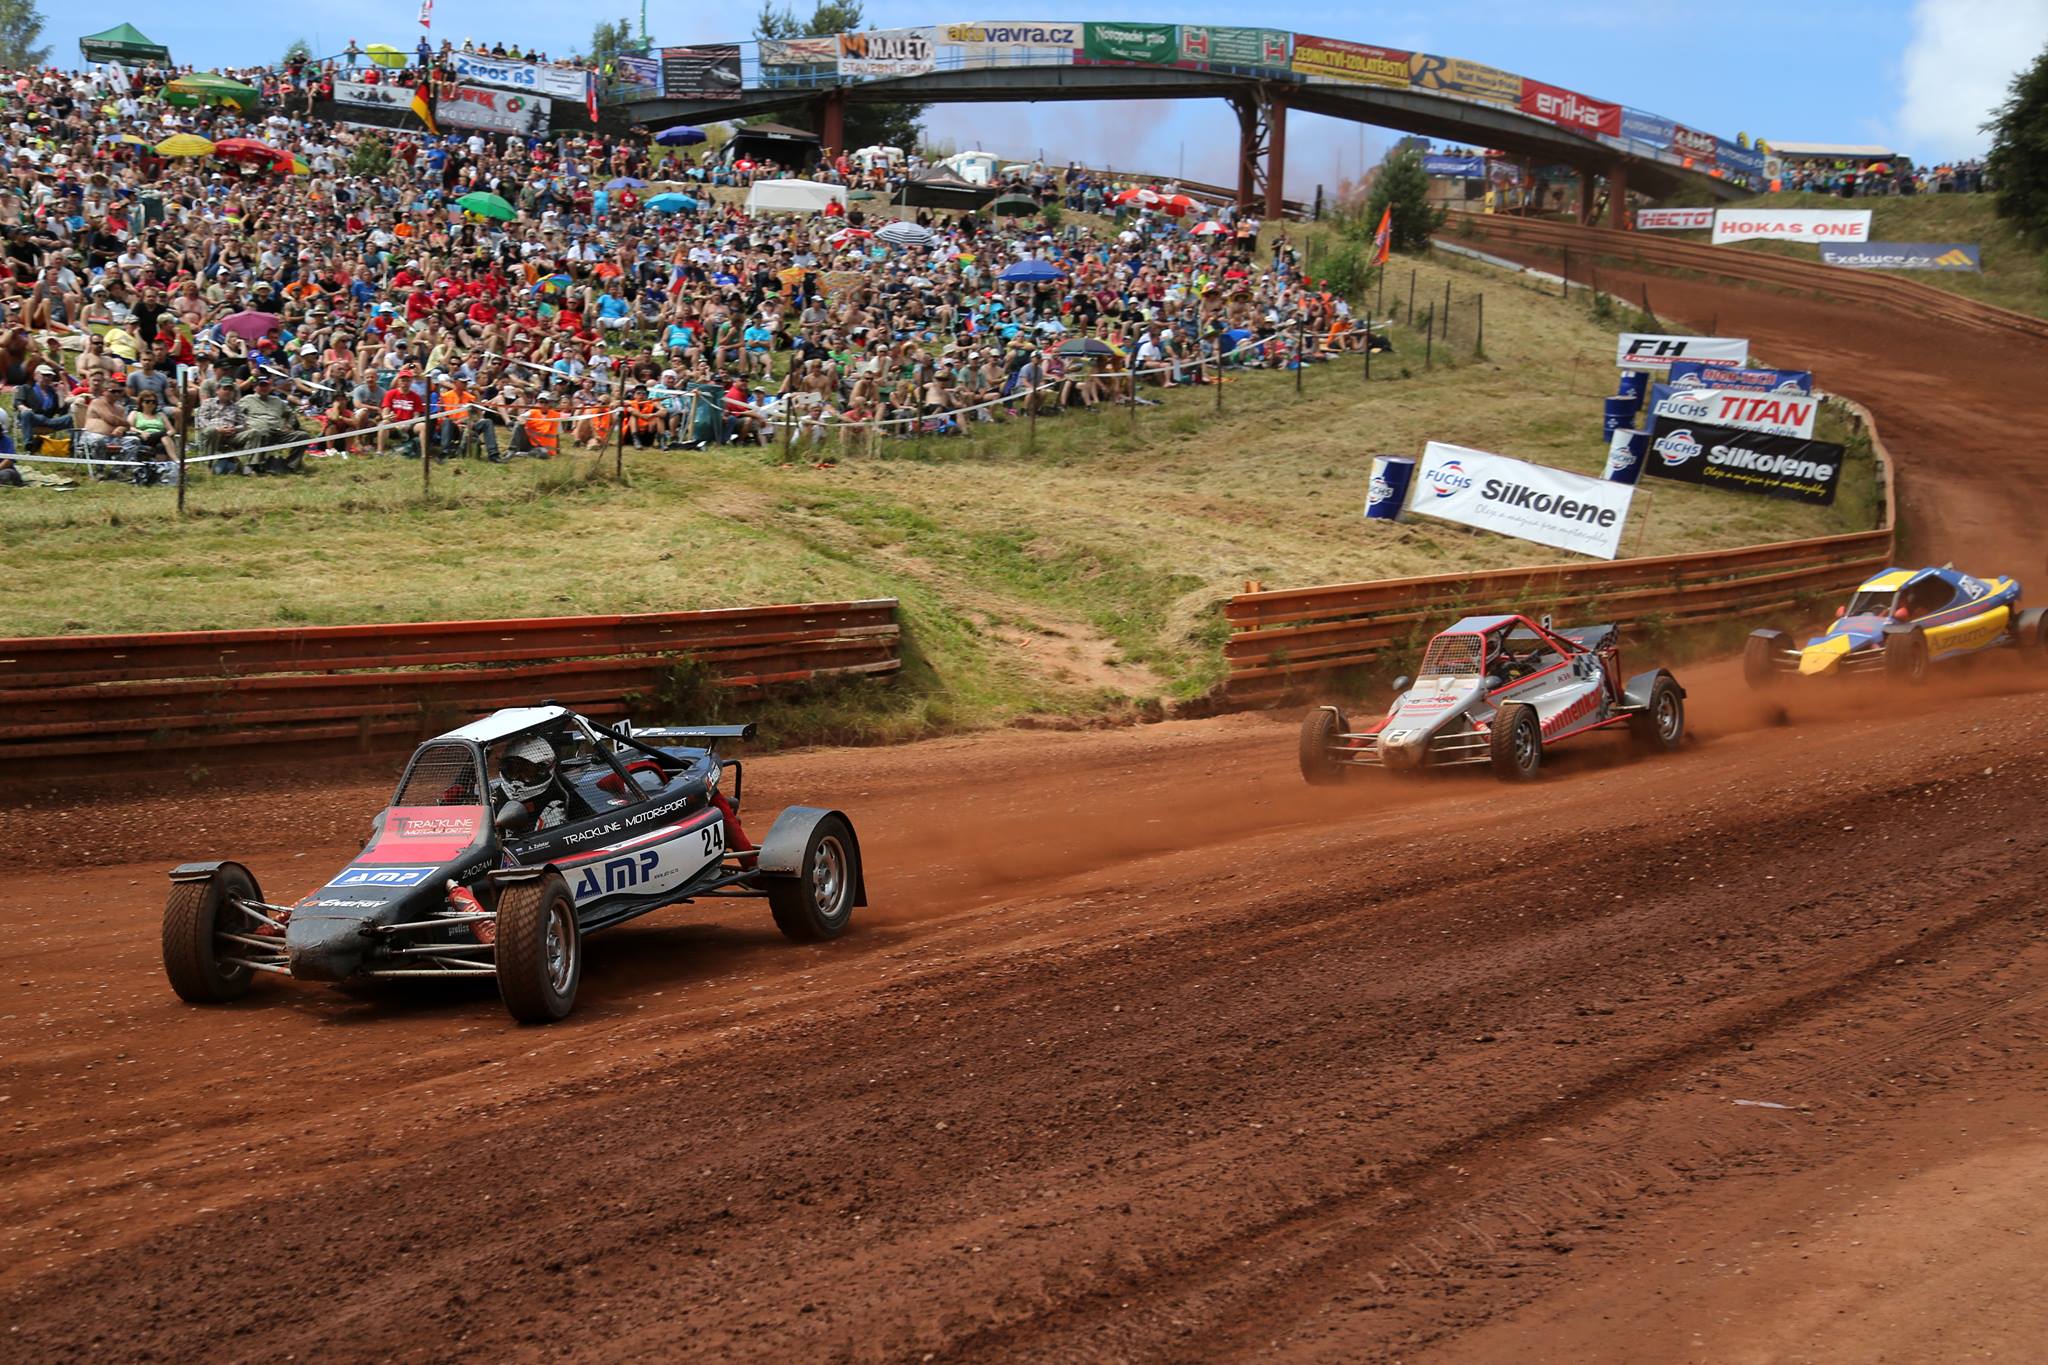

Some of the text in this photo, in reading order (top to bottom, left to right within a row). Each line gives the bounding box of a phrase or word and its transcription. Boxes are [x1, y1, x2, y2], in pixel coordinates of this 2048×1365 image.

[947, 23, 1074, 43] akuvavra.cz
[1536, 93, 1599, 127] enika
[1721, 222, 1864, 236] HOKAS ONE
[1626, 339, 1688, 356] FH
[1656, 402, 1709, 417] FUCHS
[1719, 396, 1811, 427] TITAN
[1655, 439, 1702, 456] FUCHS
[1707, 445, 1833, 481] Silkolene
[1425, 469, 1472, 489] FUCHS
[1481, 479, 1617, 528] Silkolene
[407, 818, 473, 829] TRACKLINE
[563, 797, 687, 846] TRACKLINE MOTORSPORT
[701, 824, 723, 857] 24
[344, 871, 420, 884] AMP
[575, 850, 660, 900] AMP
